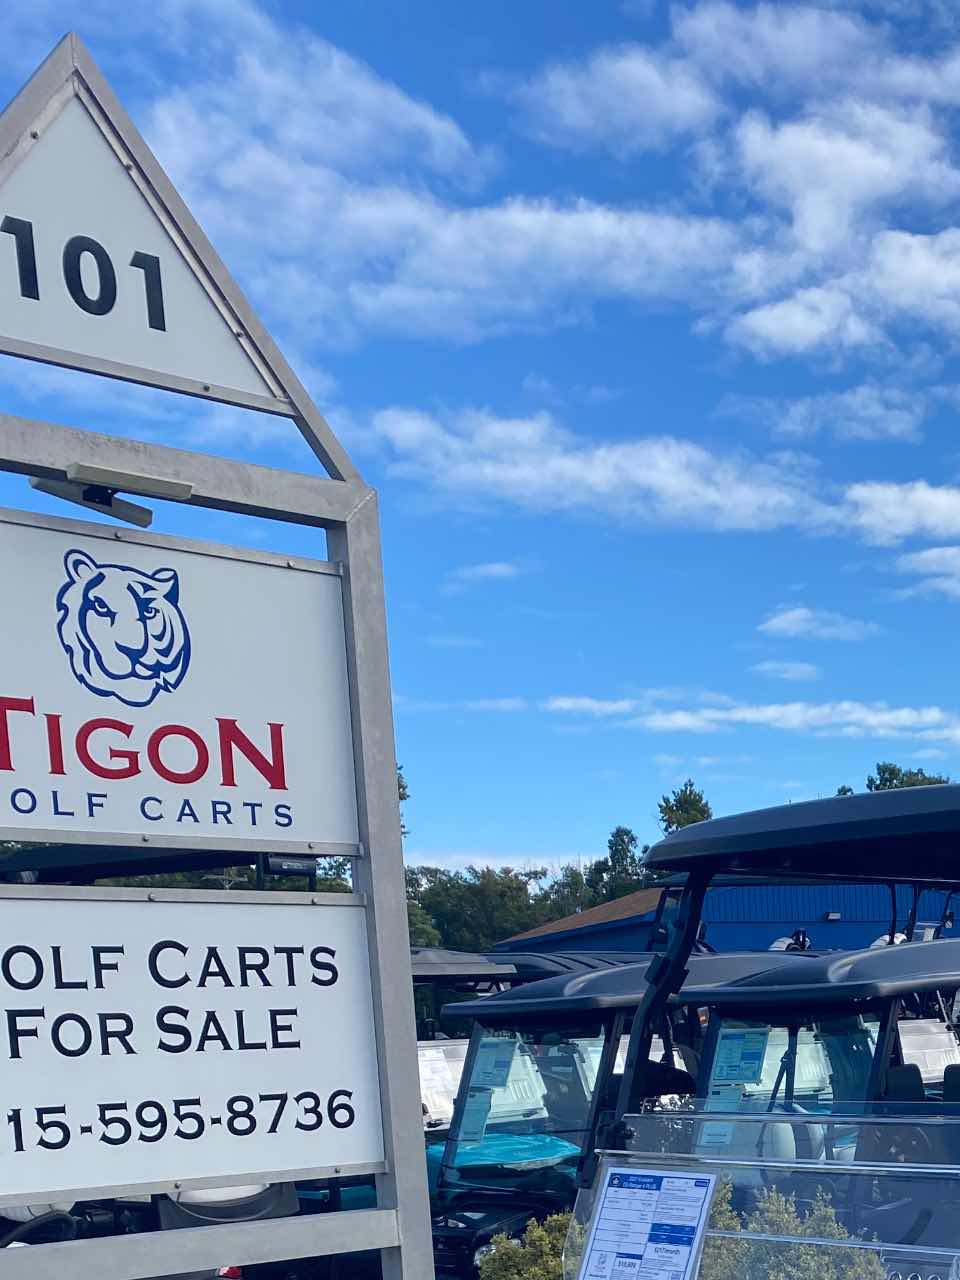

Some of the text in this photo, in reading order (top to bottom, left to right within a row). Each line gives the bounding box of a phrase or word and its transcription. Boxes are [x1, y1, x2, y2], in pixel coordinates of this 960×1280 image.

[0, 215, 167, 333] 101
[139, 796, 294, 828] CARTS
[148, 939, 339, 989] CARTS
[4, 1004, 302, 1060] FOR SALE
[6, 1088, 356, 1153] 15-595-8736
